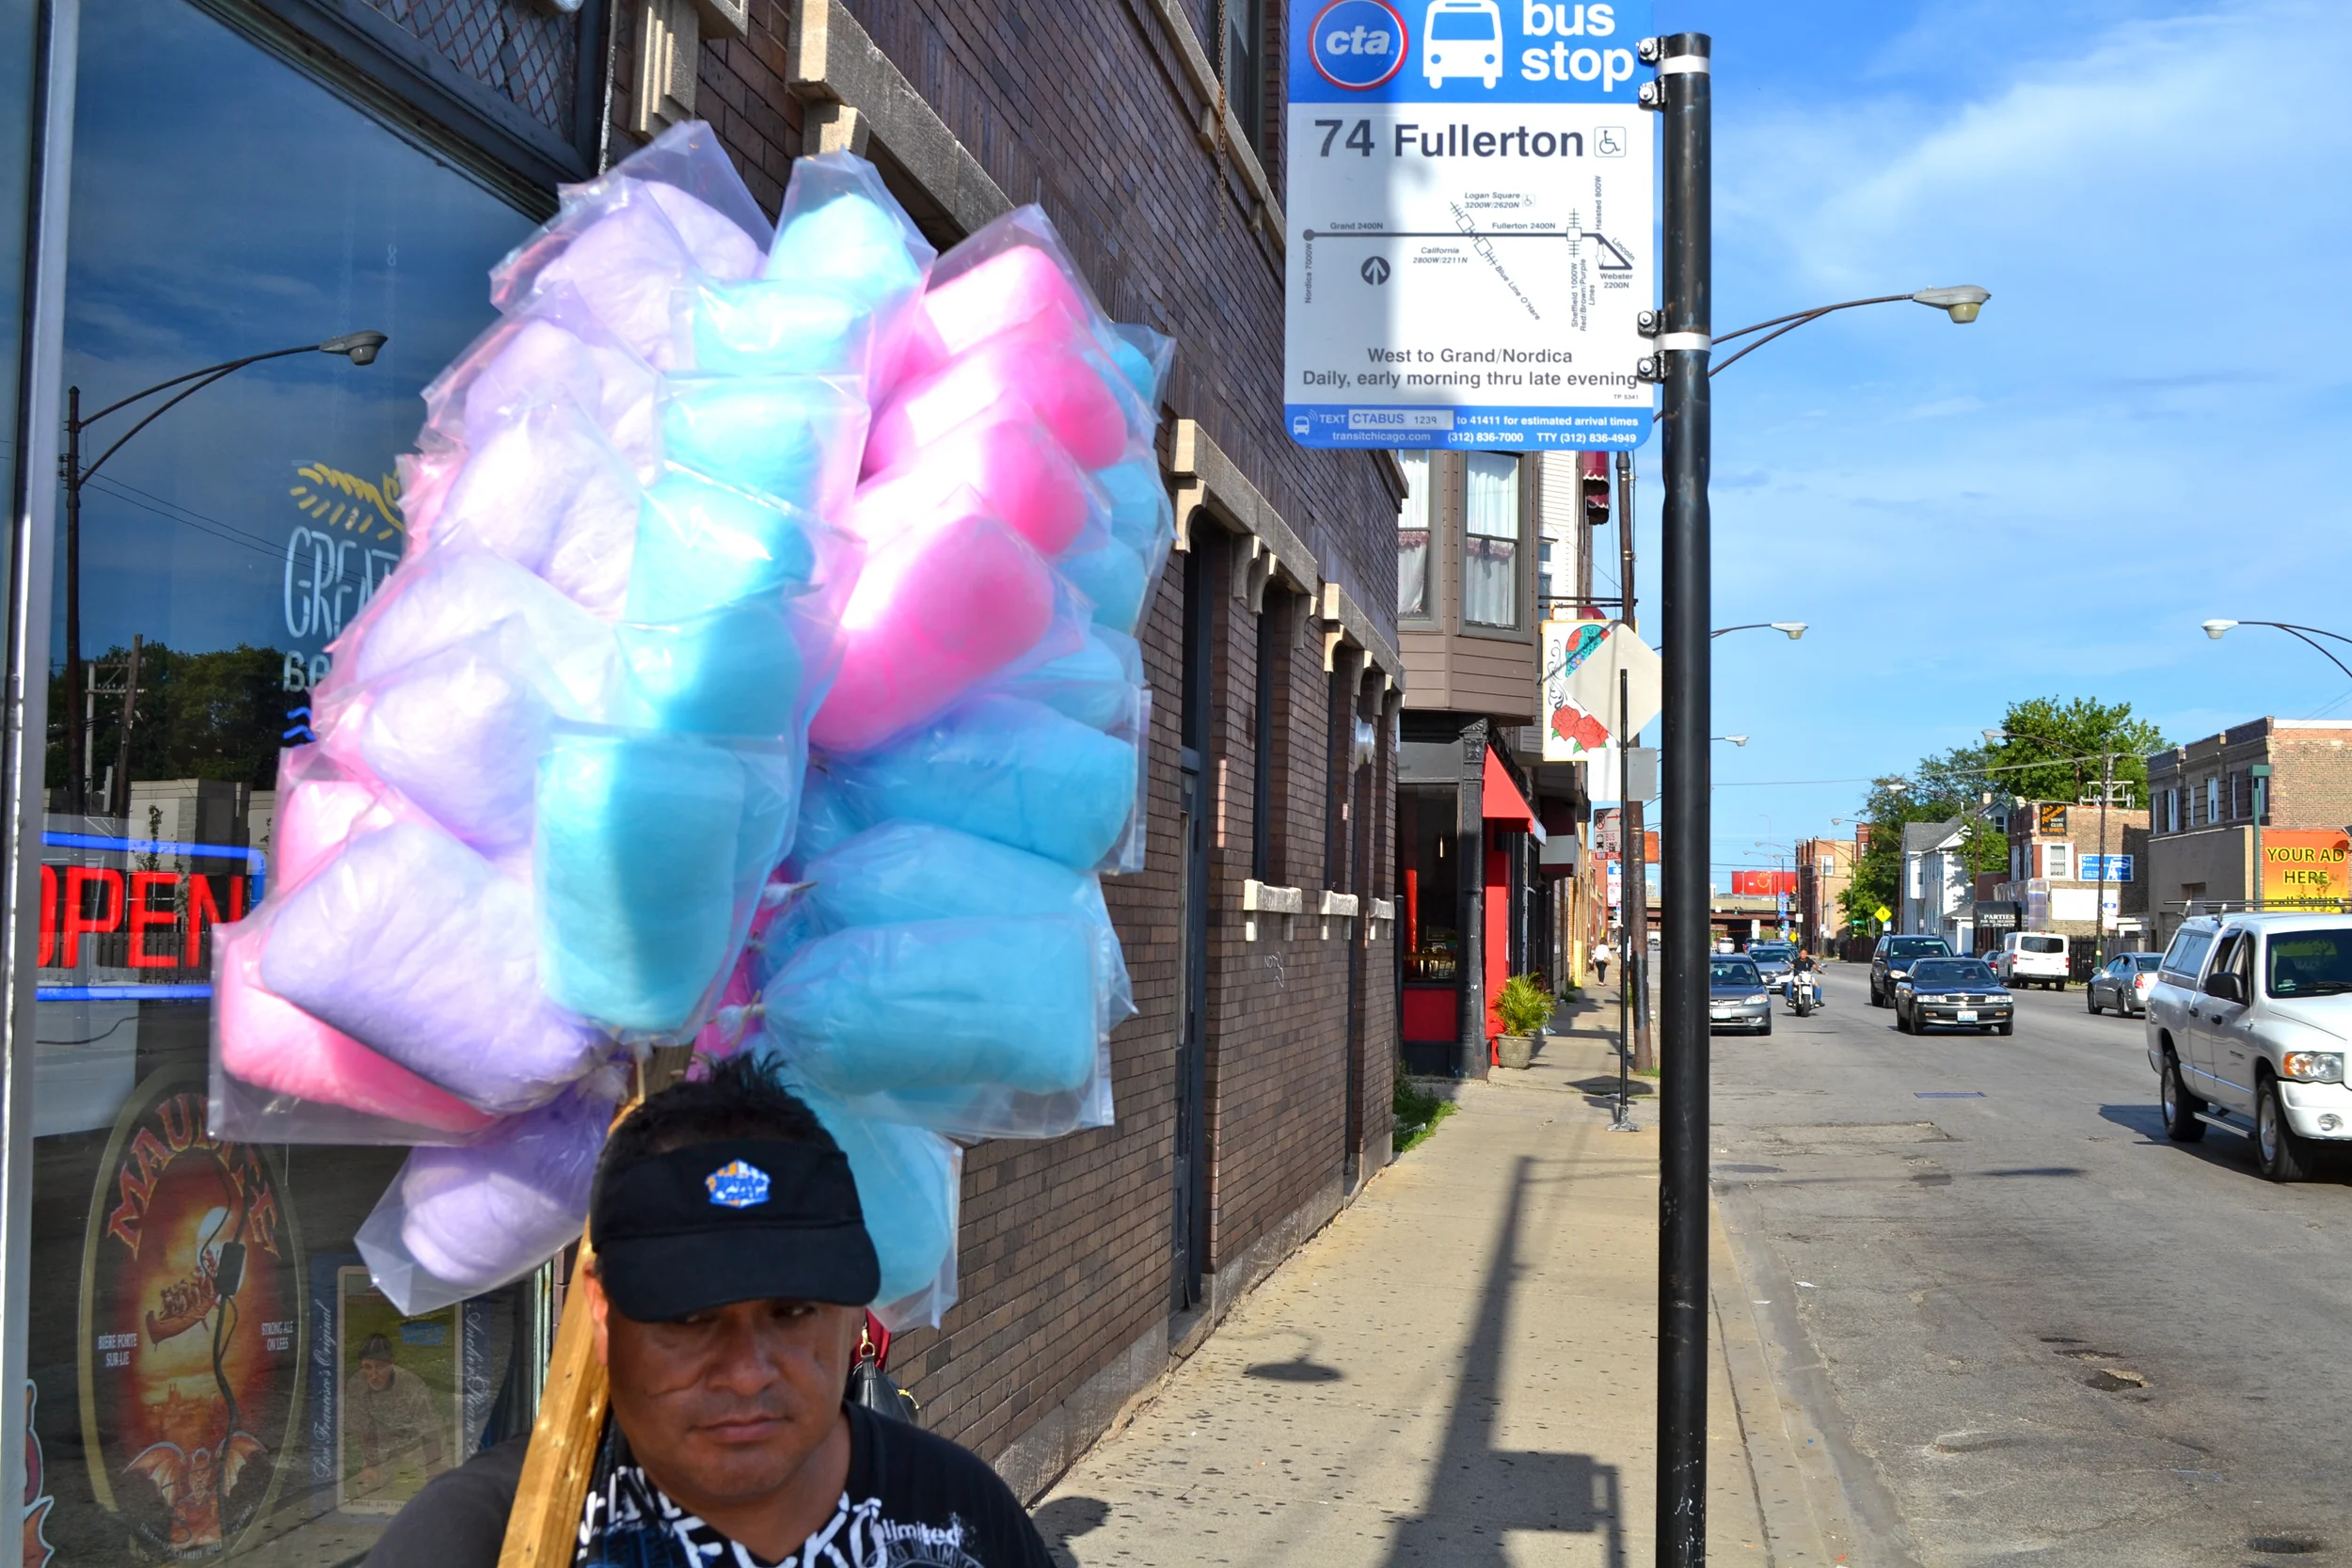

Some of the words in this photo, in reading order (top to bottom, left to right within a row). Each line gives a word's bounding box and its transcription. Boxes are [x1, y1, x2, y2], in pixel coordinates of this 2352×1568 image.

[1522, 0, 1616, 37] bus
[1326, 25, 1391, 55] cta
[1520, 40, 1635, 92] stop
[1314, 119, 1375, 158] 74
[1394, 123, 1584, 158] Fullerton
[1464, 191, 1489, 200] Logan
[1492, 191, 1520, 200] Square
[1329, 222, 1356, 230] Grand
[1358, 222, 1384, 230] 2400N
[1305, 243, 1313, 270] 7000W
[1421, 246, 1460, 255] California
[1611, 237, 1636, 262] Lincoln
[1412, 256, 1468, 264] 2800W/2211N
[1304, 272, 1312, 304] Nordica
[1495, 265, 1510, 282] Blue
[1507, 281, 1521, 297] Line
[1520, 296, 1541, 321] O'Hare
[1367, 347, 1412, 363] West
[1417, 349, 1435, 363] to
[1440, 348, 1573, 364] Grand/Nordica
[1302, 370, 1351, 388] Daily,
[1357, 370, 1401, 388] early
[1406, 371, 1481, 389] morning
[1486, 371, 1522, 386] thru
[1529, 371, 1562, 386] late
[1566, 371, 1638, 389] evening
[1319, 414, 1346, 424] TEXT
[1352, 413, 1405, 424] CTABUS
[1414, 415, 1438, 424] 1239
[1456, 416, 1468, 425] to
[1470, 415, 1501, 425] 41411
[1504, 415, 1518, 425] for
[1520, 416, 1572, 426] estimated
[1574, 416, 1608, 426] arrival
[1610, 417, 1639, 427] times
[1331, 431, 1431, 443] transitchicago.com
[1447, 431, 1474, 444] (312)
[1476, 432, 1524, 442] 836-7000
[1536, 432, 1558, 442] TTY
[1560, 433, 1586, 445] (312)
[1589, 433, 1637, 443] 836-4949
[2266, 847, 2315, 863] YOUR
[2319, 847, 2345, 863] AD
[2283, 870, 2329, 884] HERE
[106, 1092, 281, 1261] MAUTE
[261, 1322, 283, 1337] STRONG
[283, 1321, 294, 1334] ALE
[313, 1298, 337, 1368] Original
[118, 1333, 138, 1349] FORTE
[267, 1338, 277, 1352] ON
[277, 1338, 290, 1352] LEES
[312, 1370, 332, 1446] Francisco's
